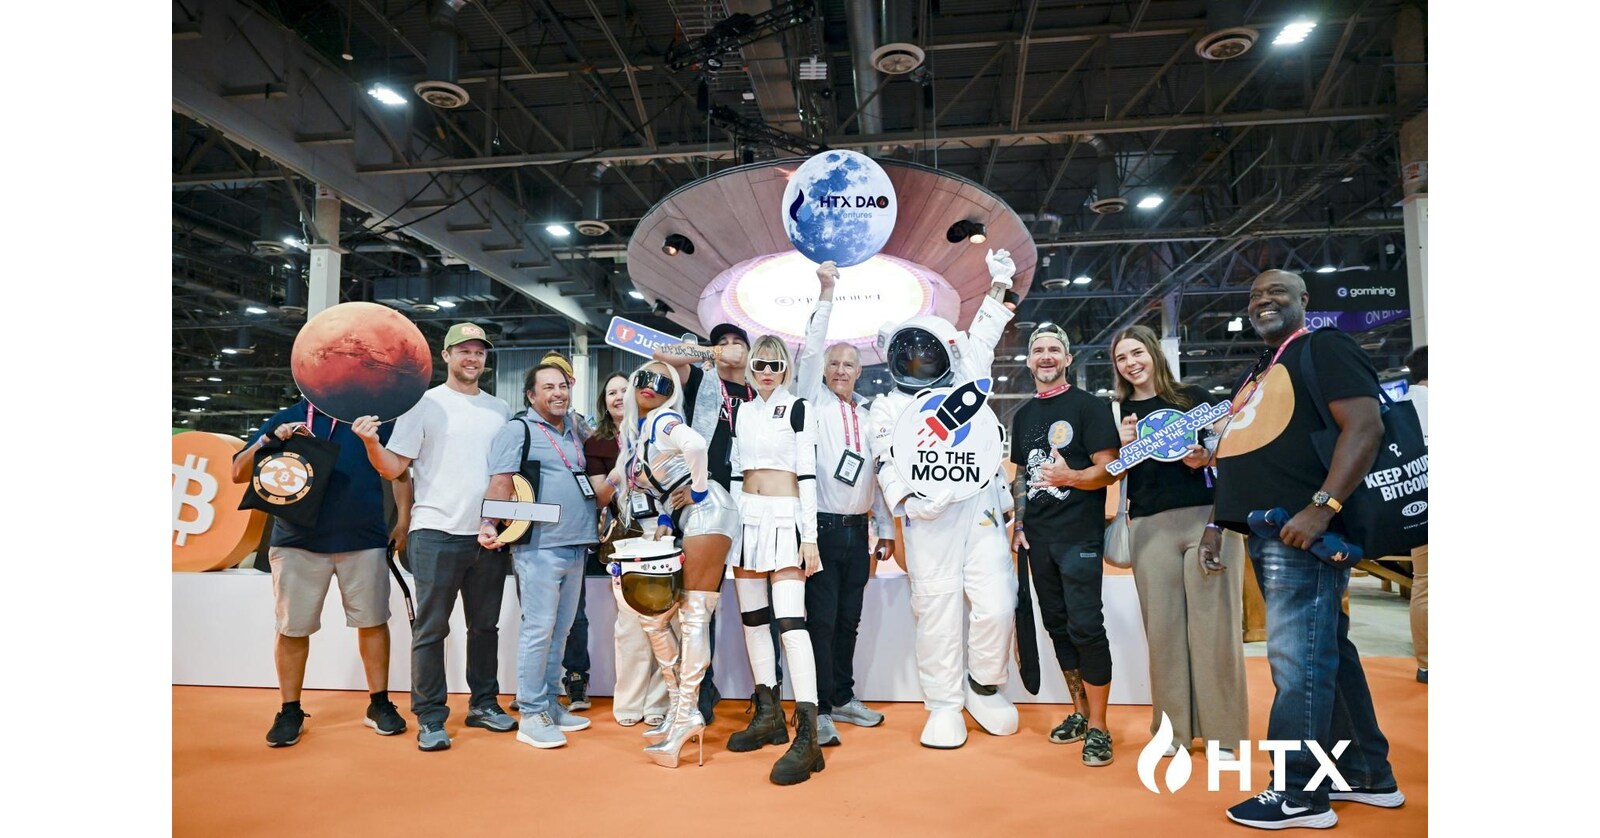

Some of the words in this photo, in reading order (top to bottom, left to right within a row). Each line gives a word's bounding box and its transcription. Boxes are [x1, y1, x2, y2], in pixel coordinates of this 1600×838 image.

[820, 196, 852, 208] HTX
[1350, 286, 1396, 298] gomining
[1365, 310, 1380, 325] ON
[621, 328, 628, 340] I
[1108, 462, 1123, 474] TO
[1124, 439, 1166, 464] EXPLORE
[1167, 428, 1186, 441] THE
[1186, 402, 1232, 430] COSMOS!
[1122, 436, 1152, 457] JUSTIN
[1152, 417, 1188, 441] INVITES
[1187, 405, 1209, 420] YOU
[917, 450, 939, 463] TO
[945, 451, 976, 465] THE
[911, 464, 980, 482] MOON
[1364, 467, 1402, 489] KEEP
